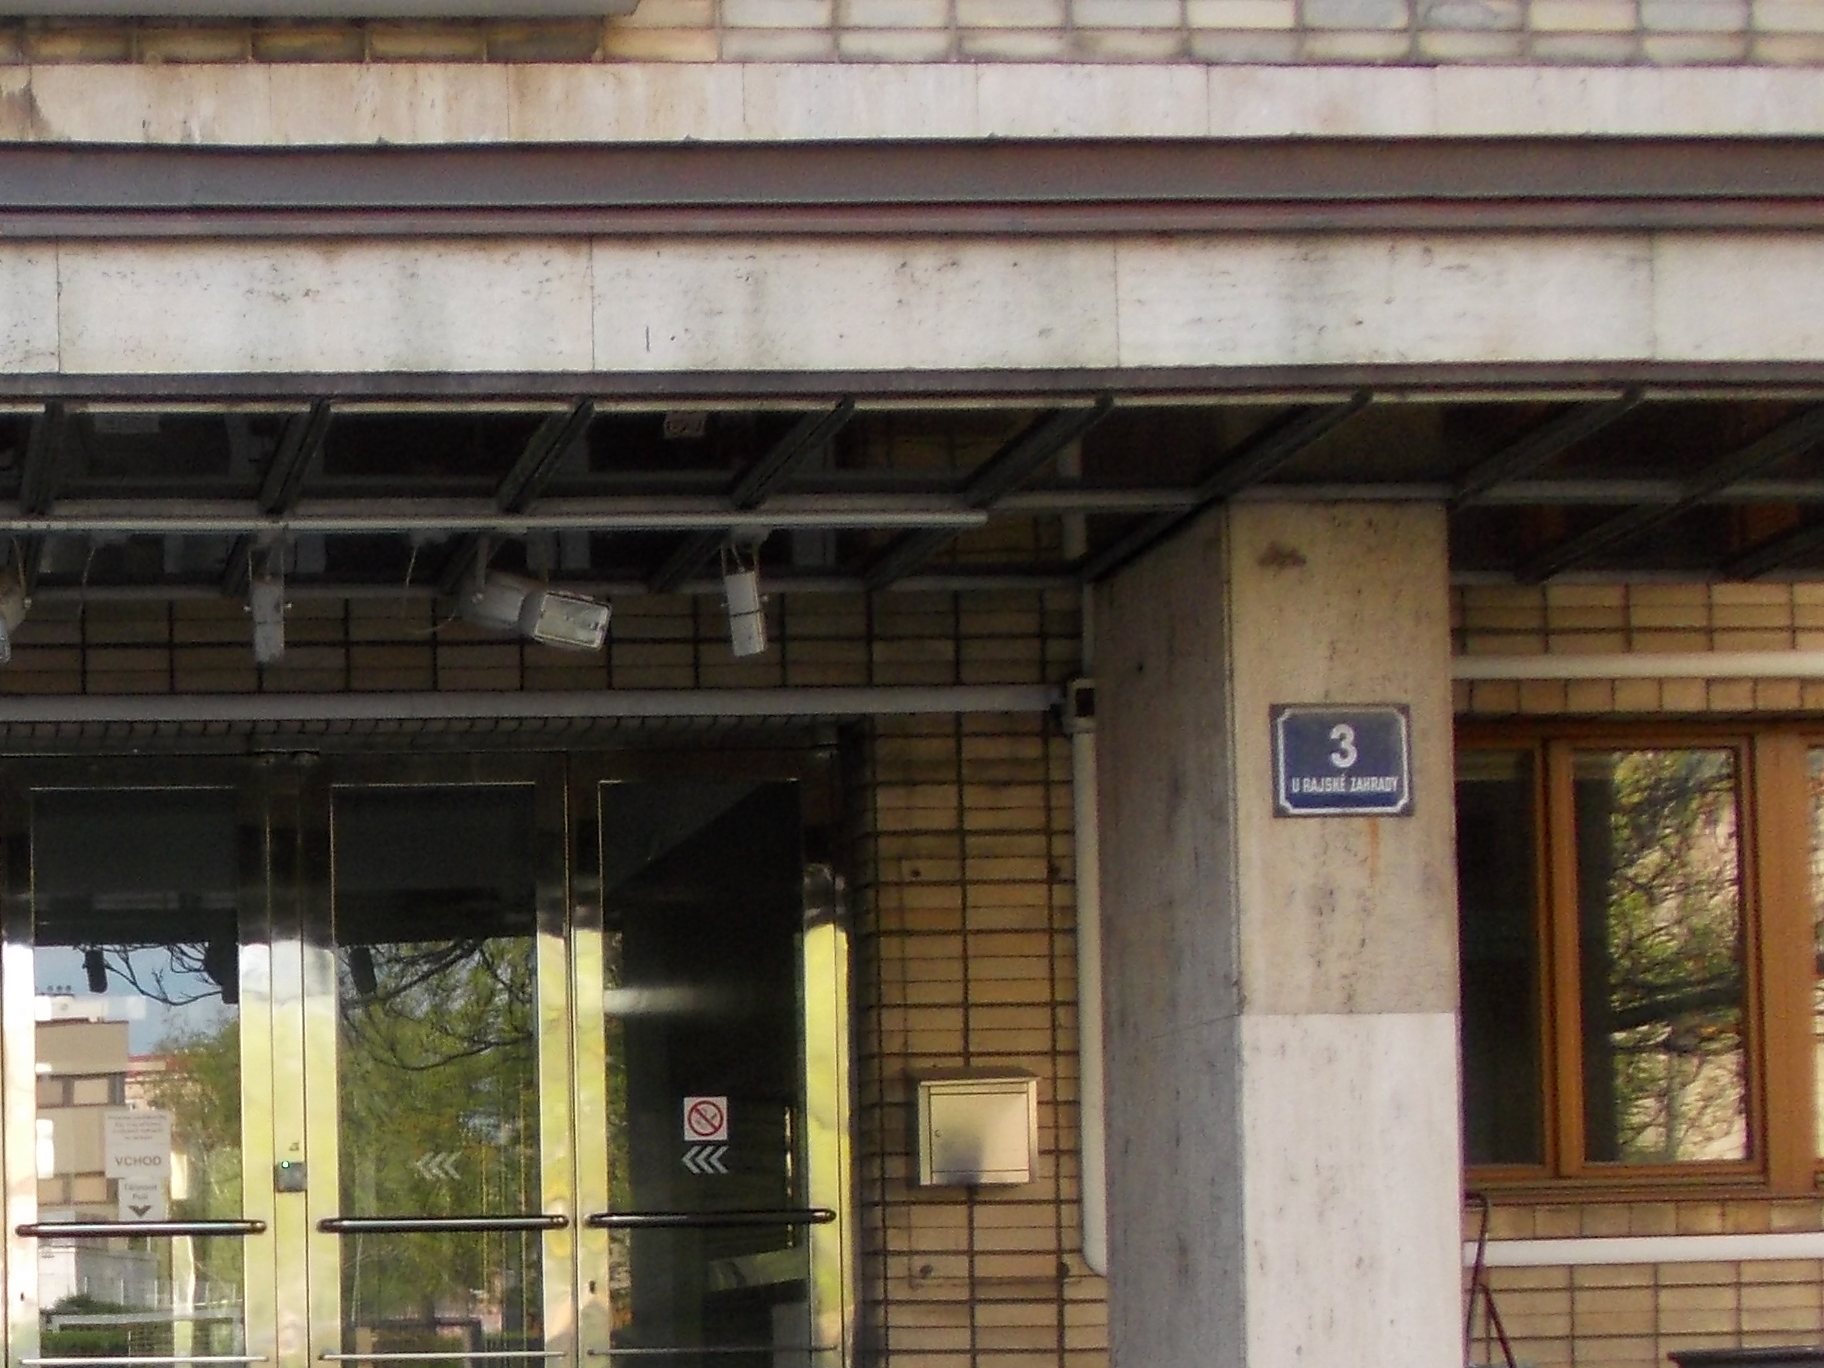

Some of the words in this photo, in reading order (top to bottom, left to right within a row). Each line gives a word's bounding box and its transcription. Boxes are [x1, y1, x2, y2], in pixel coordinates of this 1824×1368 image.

[1330, 724, 1358, 768] 3
[1292, 777, 1300, 793] U
[1303, 774, 1346, 793] RAJSKÉ
[1350, 776, 1399, 792] ZAHRADY
[115, 1155, 162, 1167] VCHOD
